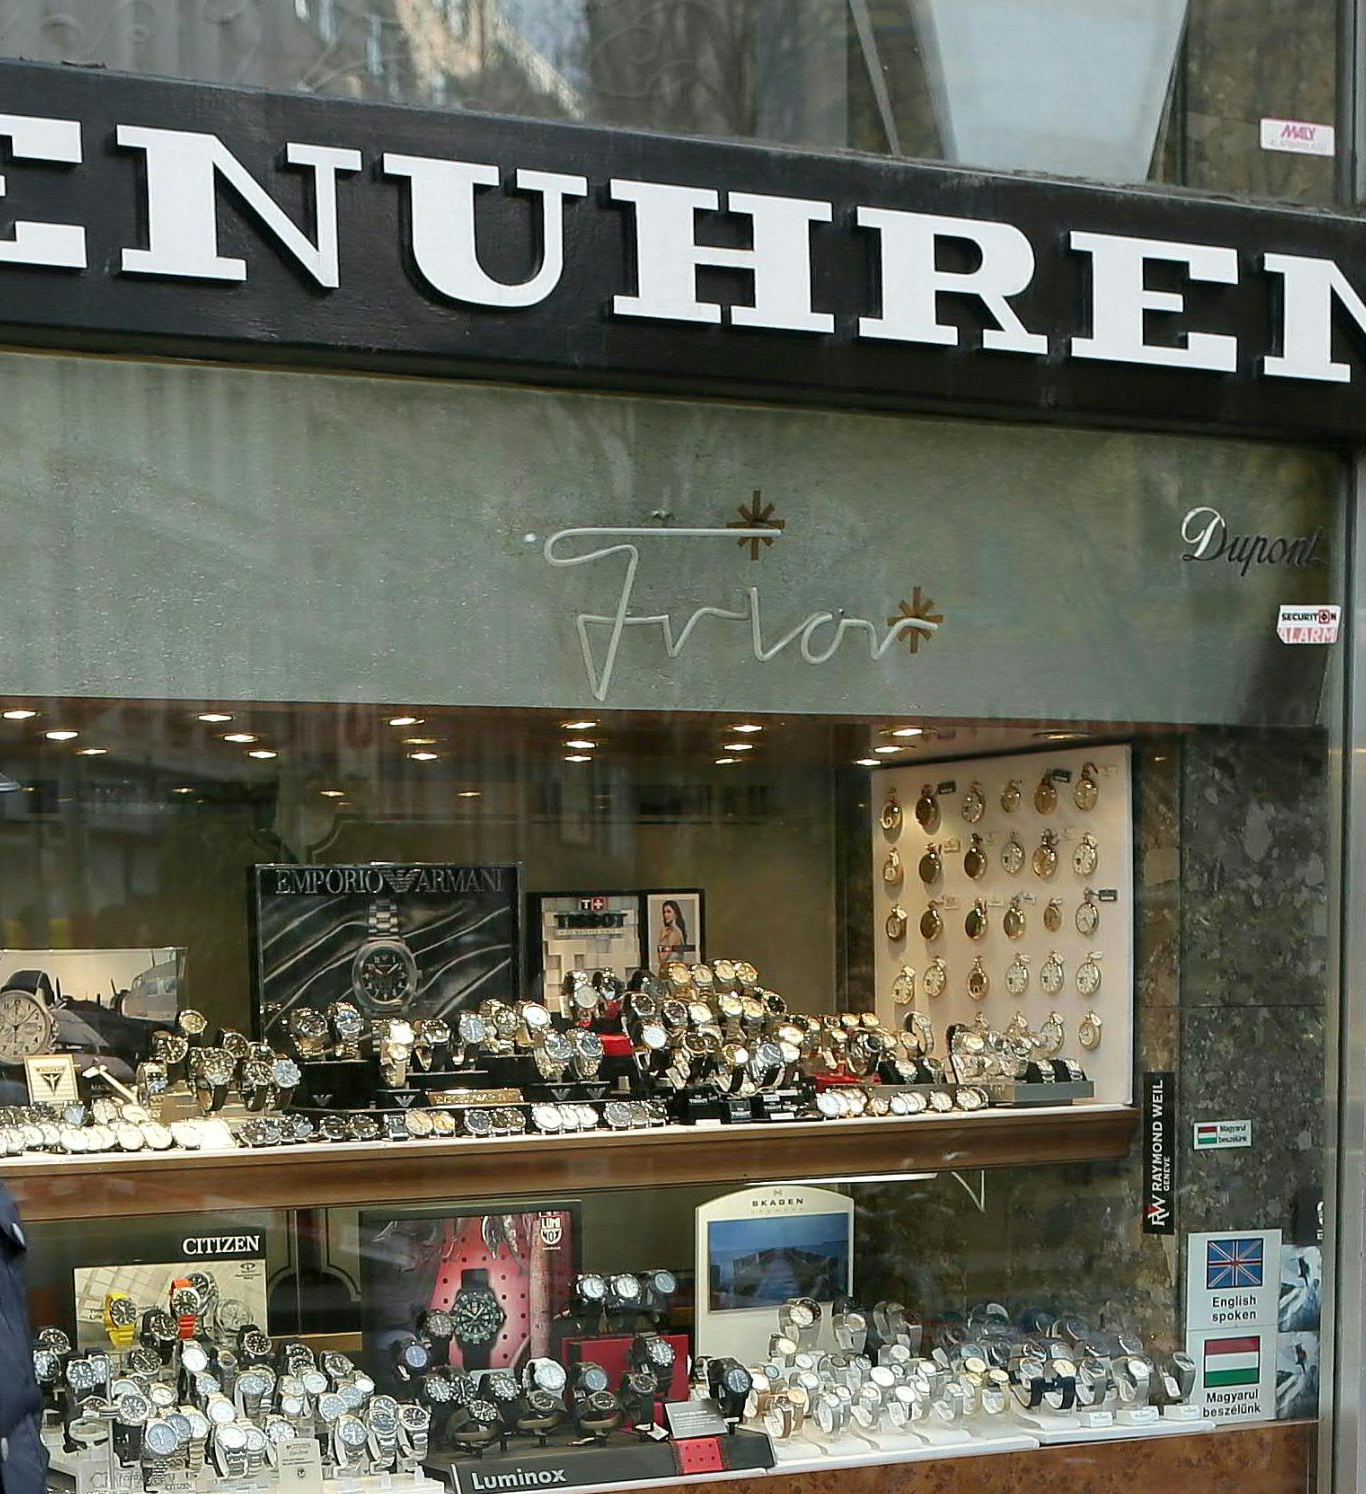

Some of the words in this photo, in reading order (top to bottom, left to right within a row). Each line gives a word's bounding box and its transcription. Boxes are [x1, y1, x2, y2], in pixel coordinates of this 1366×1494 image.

[1181, 506, 1330, 577] Dupont
[1277, 626, 1337, 643] ALARM
[275, 868, 384, 895] EMPORIO
[415, 868, 504, 893] ARMANI
[1151, 1079, 1164, 1120] WEIL
[1151, 1121, 1164, 1192] RAYMOND
[1162, 1156, 1172, 1192] GENEVE
[182, 1235, 260, 1255] CITIZEN
[1212, 1294, 1257, 1309] English
[1211, 1309, 1257, 1324] spoken
[1206, 1389, 1259, 1406] Magyarul
[471, 1468, 568, 1491] Luminox
